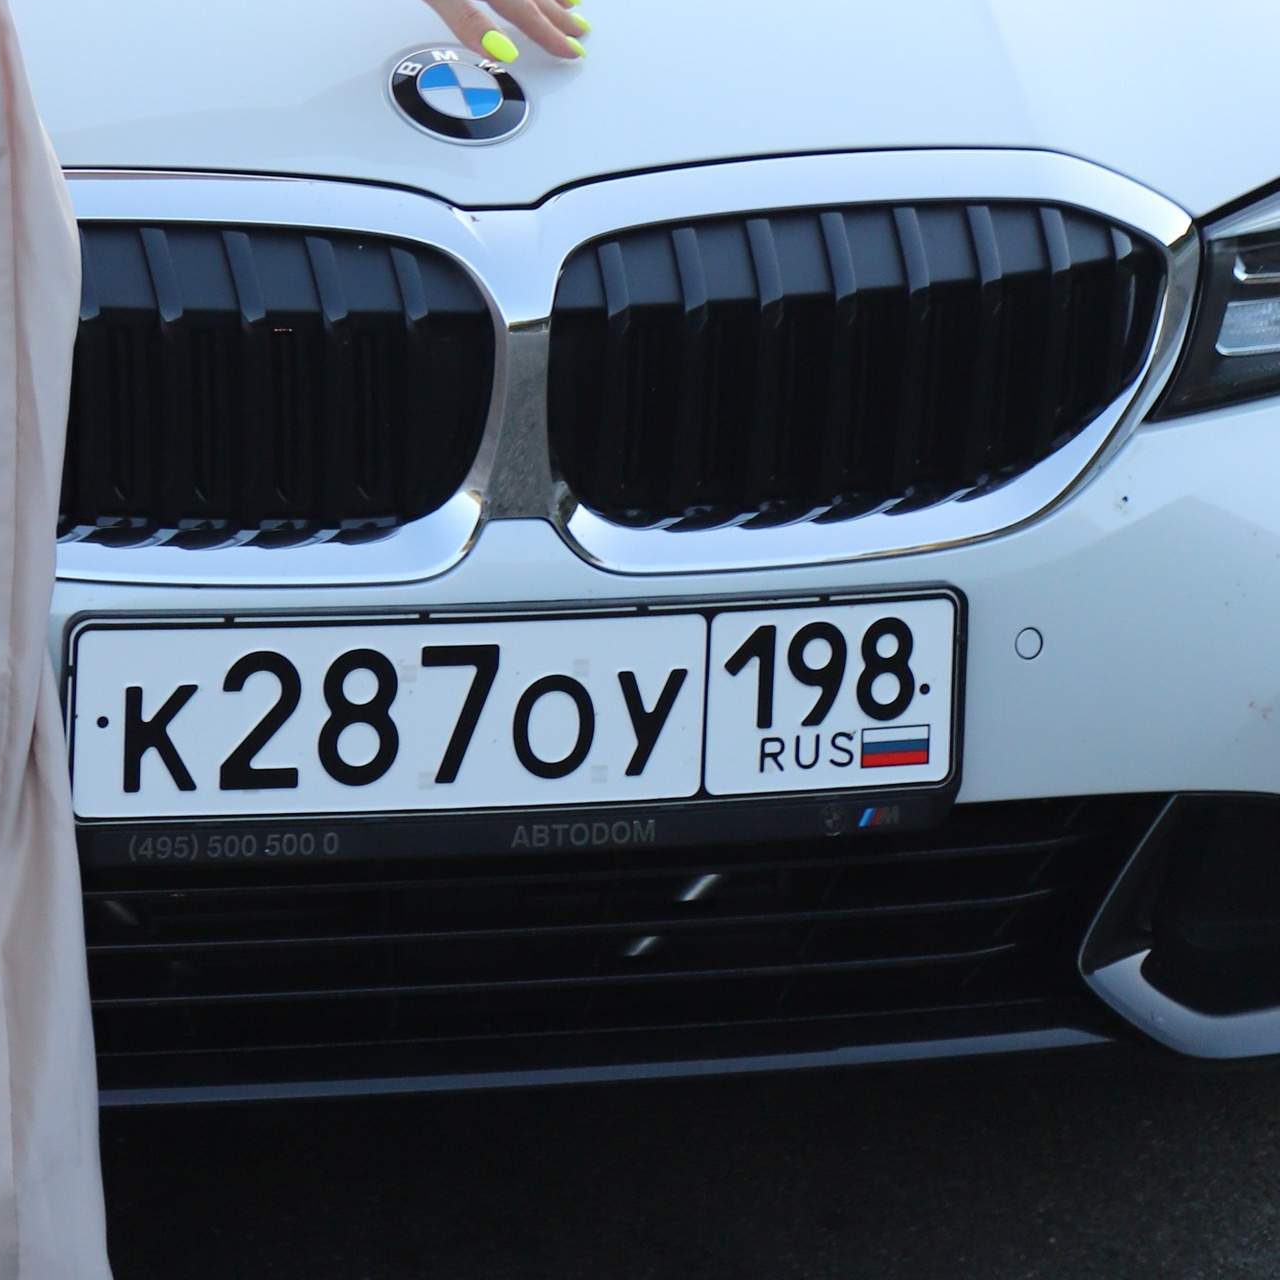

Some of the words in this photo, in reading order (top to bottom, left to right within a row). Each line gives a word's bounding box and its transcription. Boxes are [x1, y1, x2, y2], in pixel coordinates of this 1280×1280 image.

[397, 50, 506, 77] BMW
[724, 616, 916, 729] 198
[759, 730, 854, 772] RUS
[128, 834, 200, 862] (495)
[207, 834, 257, 858] 500
[265, 833, 315, 856] 500
[323, 831, 339, 855] 0
